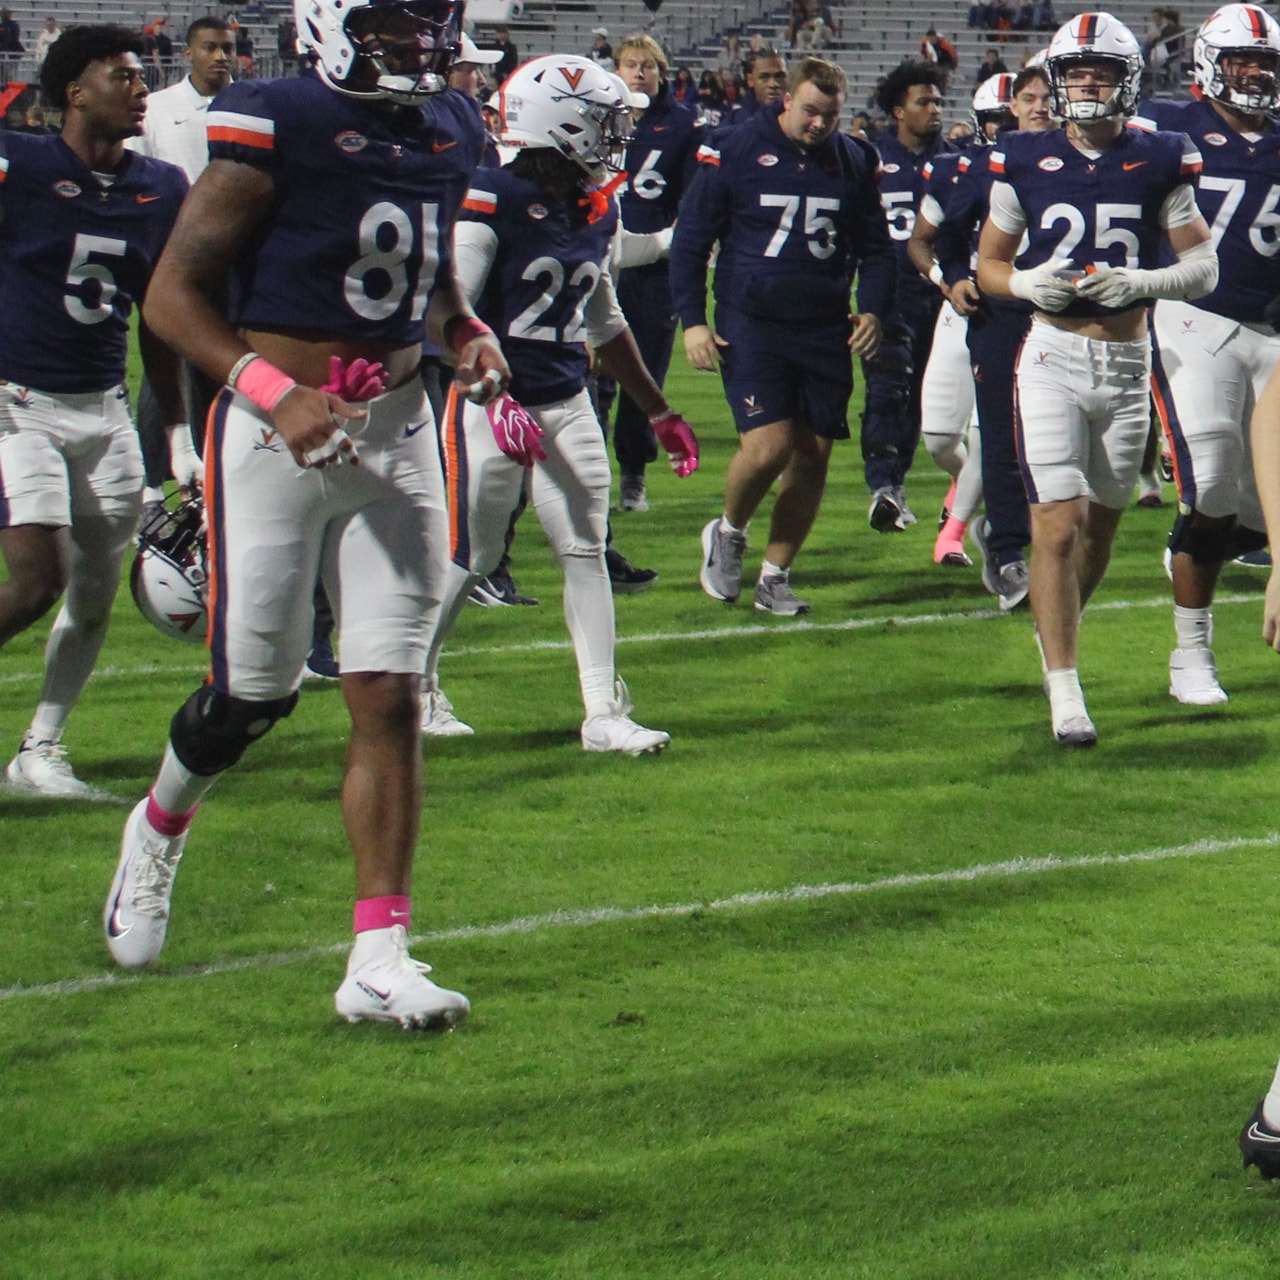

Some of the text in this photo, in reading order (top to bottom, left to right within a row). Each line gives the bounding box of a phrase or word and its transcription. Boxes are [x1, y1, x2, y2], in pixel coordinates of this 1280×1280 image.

[344, 200, 440, 322] 81
[760, 194, 841, 260] 75
[1040, 202, 1142, 273] 25
[64, 233, 127, 325] 5
[508, 256, 601, 343] 22
